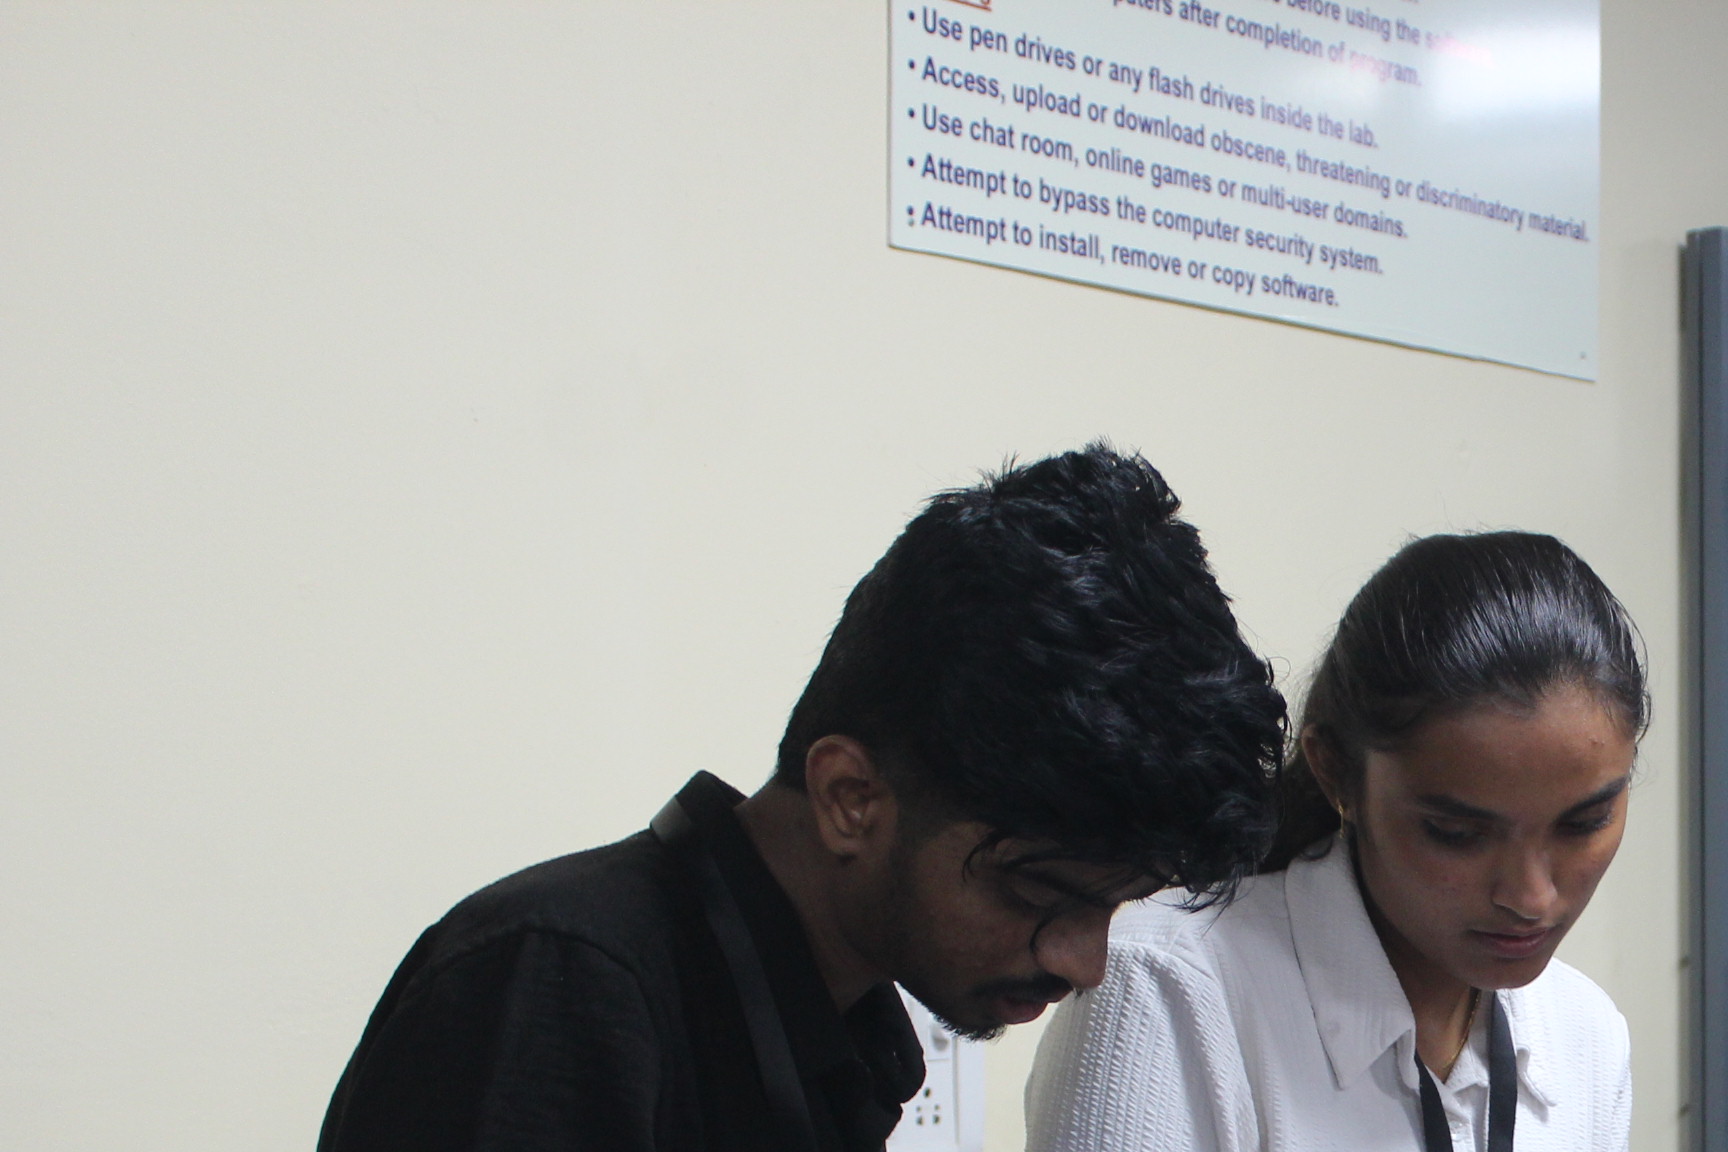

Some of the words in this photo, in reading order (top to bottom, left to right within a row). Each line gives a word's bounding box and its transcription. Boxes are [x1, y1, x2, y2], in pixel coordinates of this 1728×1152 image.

[922, 6, 963, 42] Use
[969, 25, 1008, 53] pen
[1014, 32, 1077, 71] drives
[1082, 55, 1103, 77] or
[1108, 62, 1143, 94] any
[1148, 66, 1194, 101] flash
[1199, 81, 1256, 117] drives
[1260, 95, 1313, 132] inside
[1316, 112, 1345, 141] the
[1348, 119, 1379, 149] lab.
[1178, 0, 1221, 29] after
[1225, 14, 1323, 58] completion
[1327, 40, 1346, 63] of
[1345, 7, 1392, 43] using
[1395, 18, 1421, 46] the
[921, 56, 1006, 104] Access,
[1012, 83, 1081, 118] upload
[1087, 102, 1108, 124] or
[1113, 104, 1205, 149] download
[1210, 129, 1291, 173] obscene,
[1295, 149, 1391, 200] threatening
[1394, 179, 1413, 198] or
[1415, 180, 1524, 232] discriminatory
[1528, 212, 1589, 243] material.
[922, 103, 963, 137] Use
[969, 117, 1015, 150] chat
[1021, 133, 1079, 168] room,
[1085, 147, 1145, 179] online
[1150, 163, 1213, 194] games
[1217, 178, 1237, 199] or
[1241, 184, 1330, 220] multi-user
[1333, 202, 1408, 239] domains.
[920, 202, 1007, 246] Attempt
[1012, 221, 1033, 247] to
[1039, 224, 1105, 265] install,
[1111, 244, 1182, 276] remove
[1187, 260, 1207, 280] or
[1211, 265, 1256, 296] copy
[1261, 274, 1339, 307] software.
[921, 153, 1007, 198] Attempt
[1012, 174, 1033, 200] to
[1039, 177, 1111, 217] bypass
[1116, 196, 1147, 225] the
[1152, 208, 1241, 243] computer
[1244, 228, 1315, 265] security
[1319, 244, 1384, 275] system.
